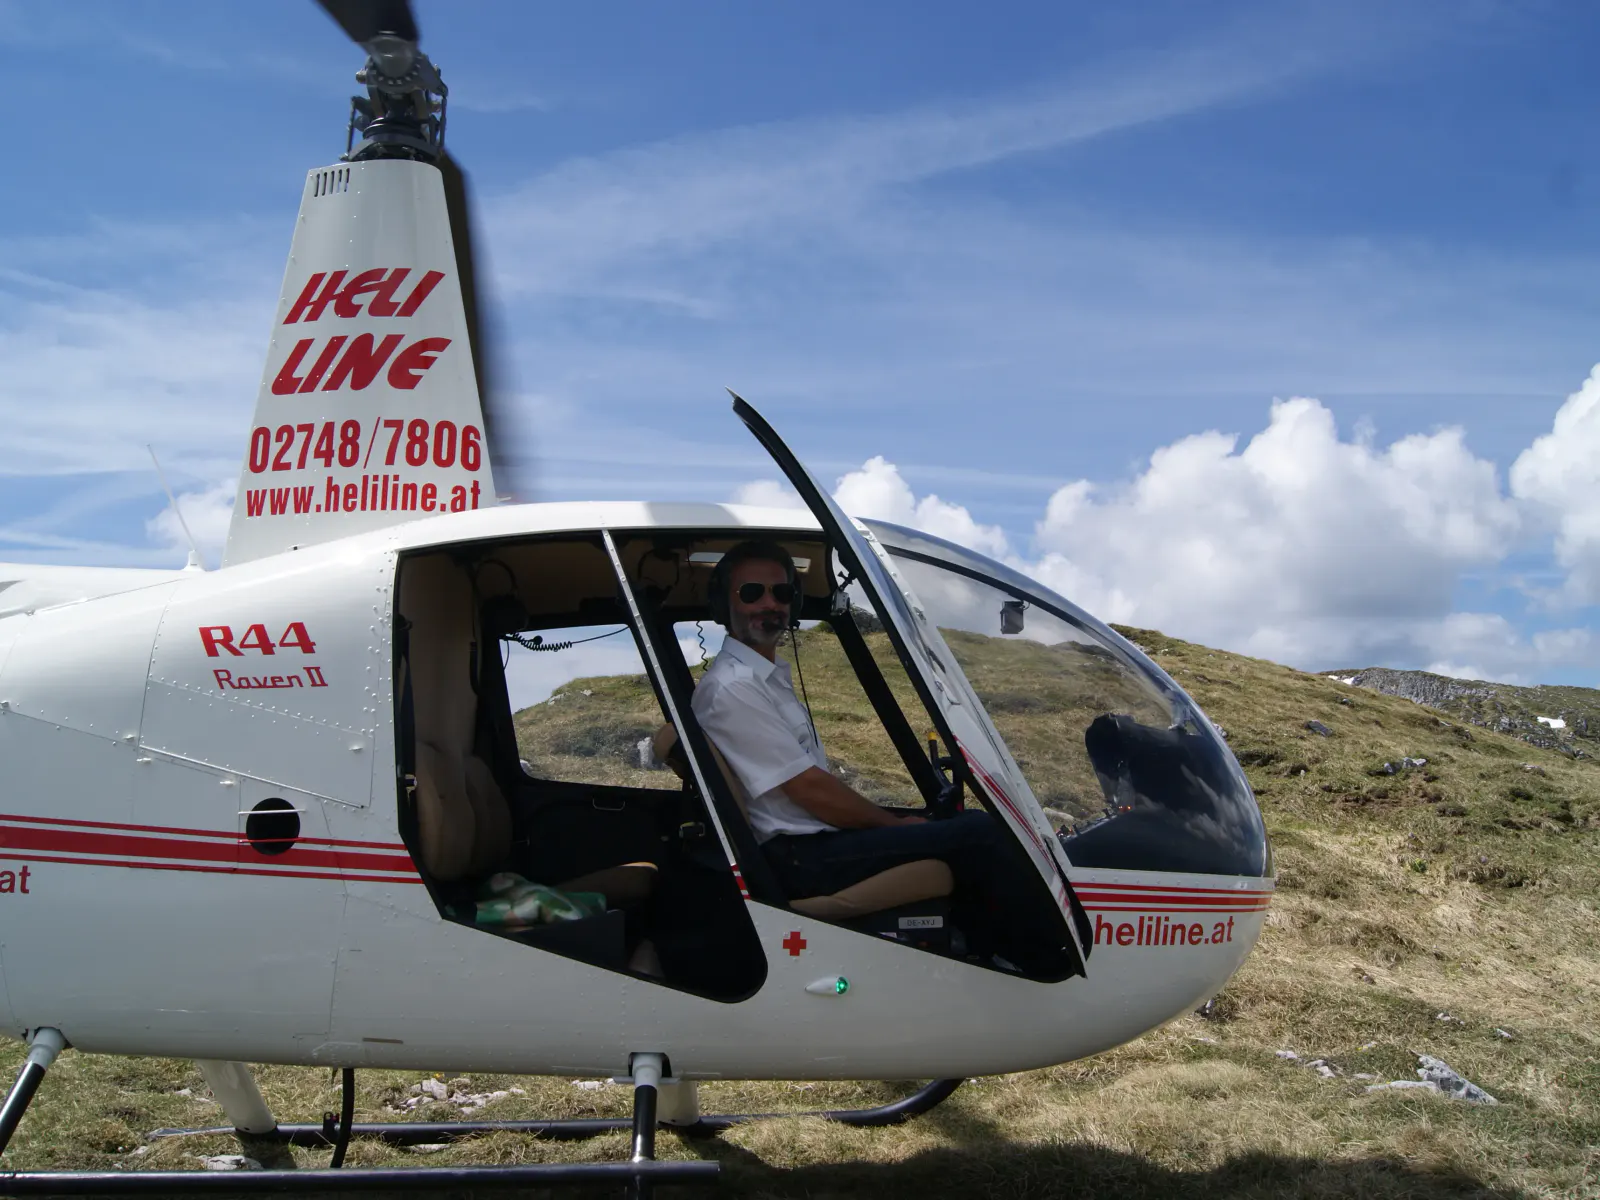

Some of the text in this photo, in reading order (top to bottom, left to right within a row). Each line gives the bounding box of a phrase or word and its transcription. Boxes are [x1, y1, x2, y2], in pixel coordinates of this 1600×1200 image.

[282, 267, 446, 325] HELI
[271, 332, 452, 396] LINE
[248, 416, 482, 474] 02748/7806
[246, 474, 481, 517] www.heliline.at
[198, 621, 317, 658] R44
[212, 666, 329, 690] Raven II
[1093, 913, 1235, 946] heliline.at
